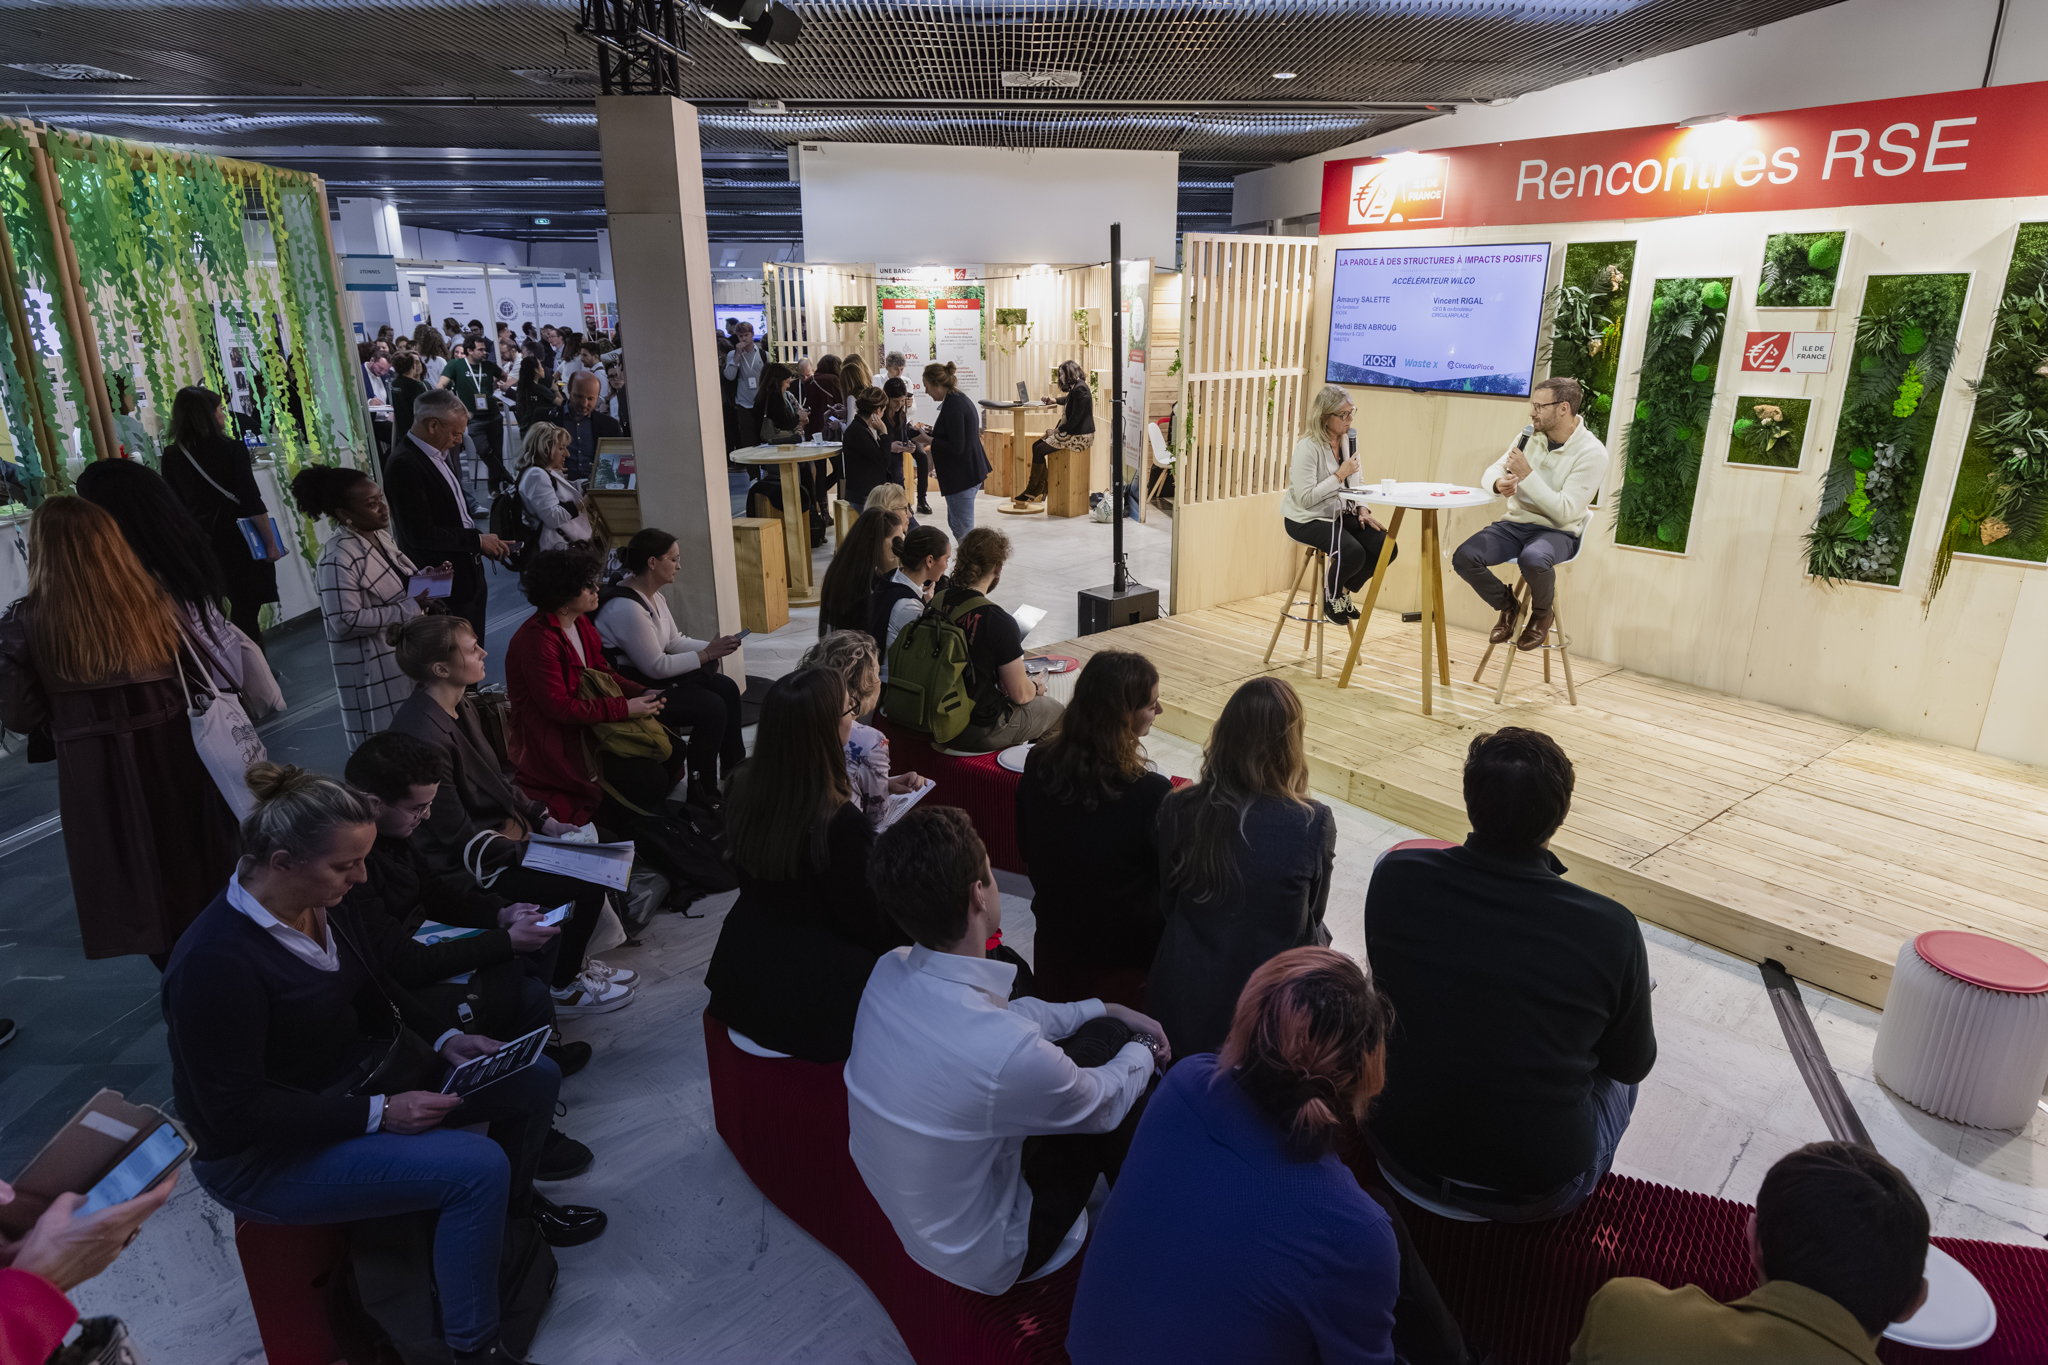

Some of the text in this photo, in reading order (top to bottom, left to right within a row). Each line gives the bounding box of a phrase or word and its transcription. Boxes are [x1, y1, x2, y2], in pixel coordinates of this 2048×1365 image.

[1516, 116, 1977, 201] Rencontres RSE
[1407, 190, 1442, 201] FRANCE
[1339, 254, 1543, 266] LA PAROLE À DES STRUCTURES À IMPACTS POSITIFS
[1392, 276, 1449, 285] ACCÉLÉRATEUR
[1336, 296, 1360, 304] Amaury
[1433, 297, 1484, 305] Vincent RIGAL
[1368, 323, 1397, 331] ABROUG
[1363, 354, 1396, 367] KIOSK
[1404, 358, 1432, 368] Waste
[1454, 362, 1494, 370] CircularPlace
